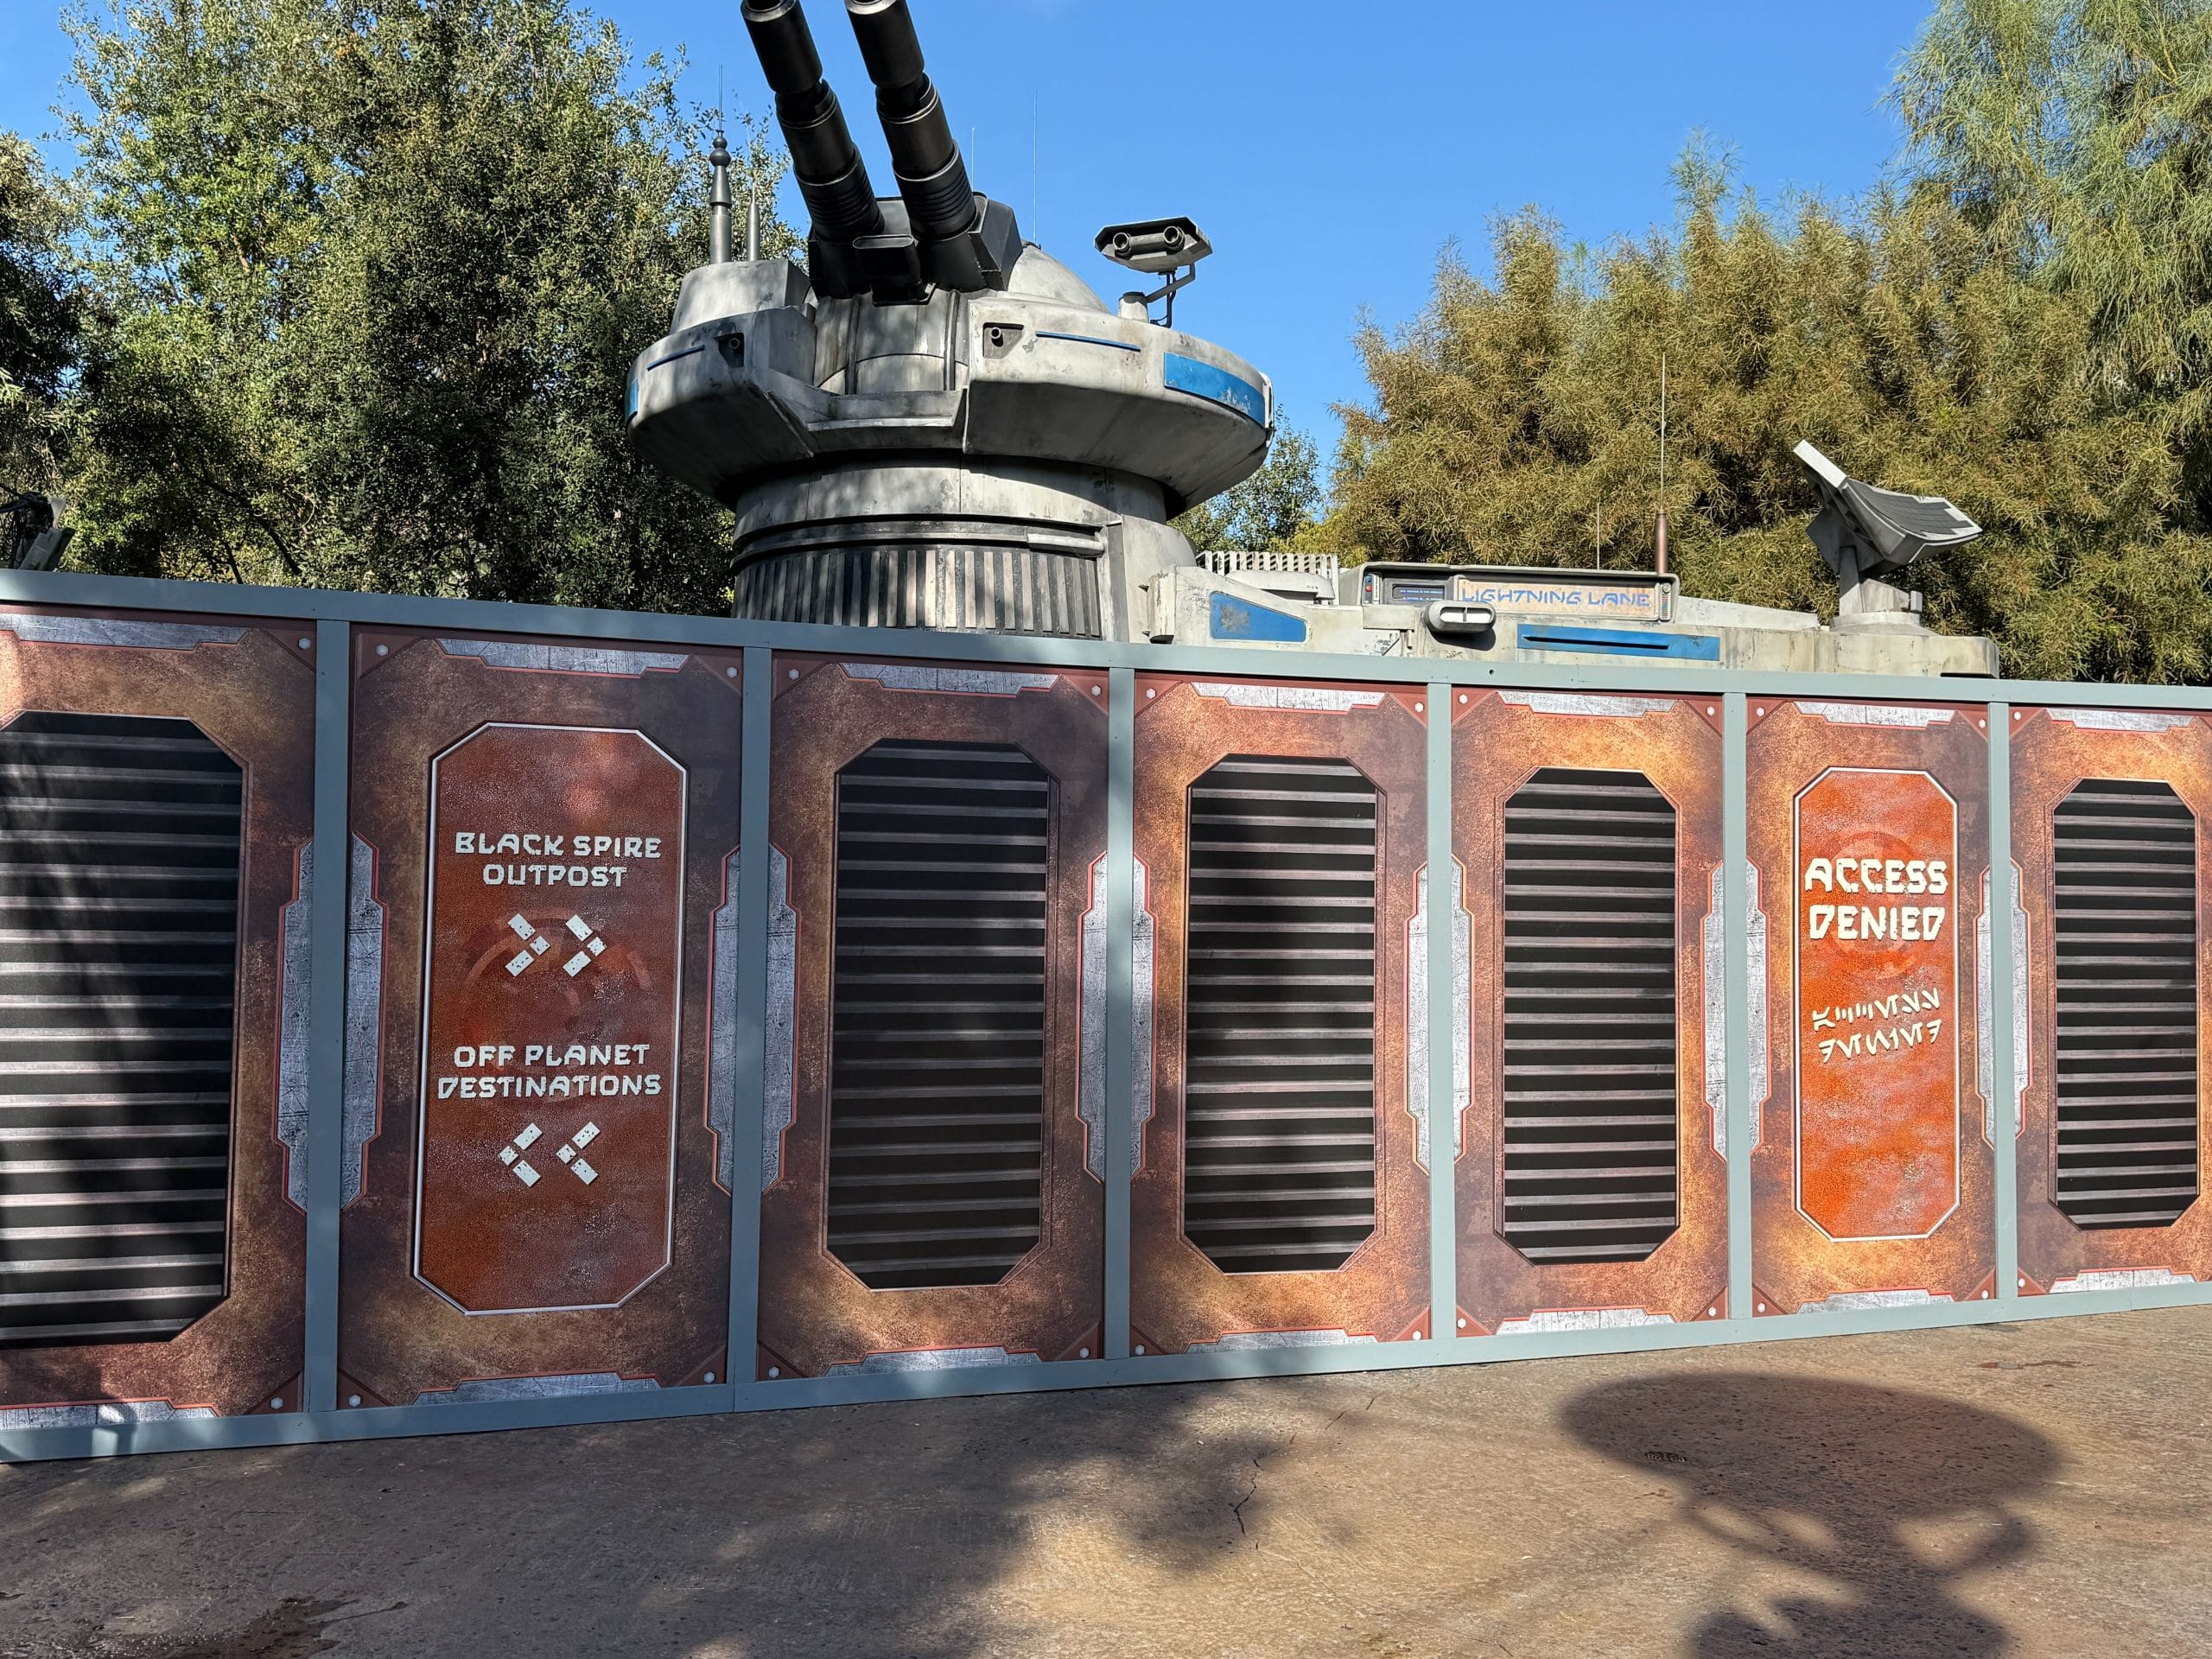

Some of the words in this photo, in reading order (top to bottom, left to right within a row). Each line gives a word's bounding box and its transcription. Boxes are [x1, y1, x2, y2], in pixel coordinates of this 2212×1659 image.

[1462, 588, 1581, 605] LIGHTNING
[1588, 592, 1649, 607] LANE
[455, 832, 564, 856] BLACK
[572, 836, 662, 859] SPIRE
[482, 863, 627, 887] OUTPOST
[1804, 857, 1948, 895] ACCESS
[1808, 905, 1946, 941] DENIED
[454, 1045, 517, 1068] OFF
[524, 1044, 651, 1066] PLANET
[437, 1074, 662, 1099] DESTINATIONS
